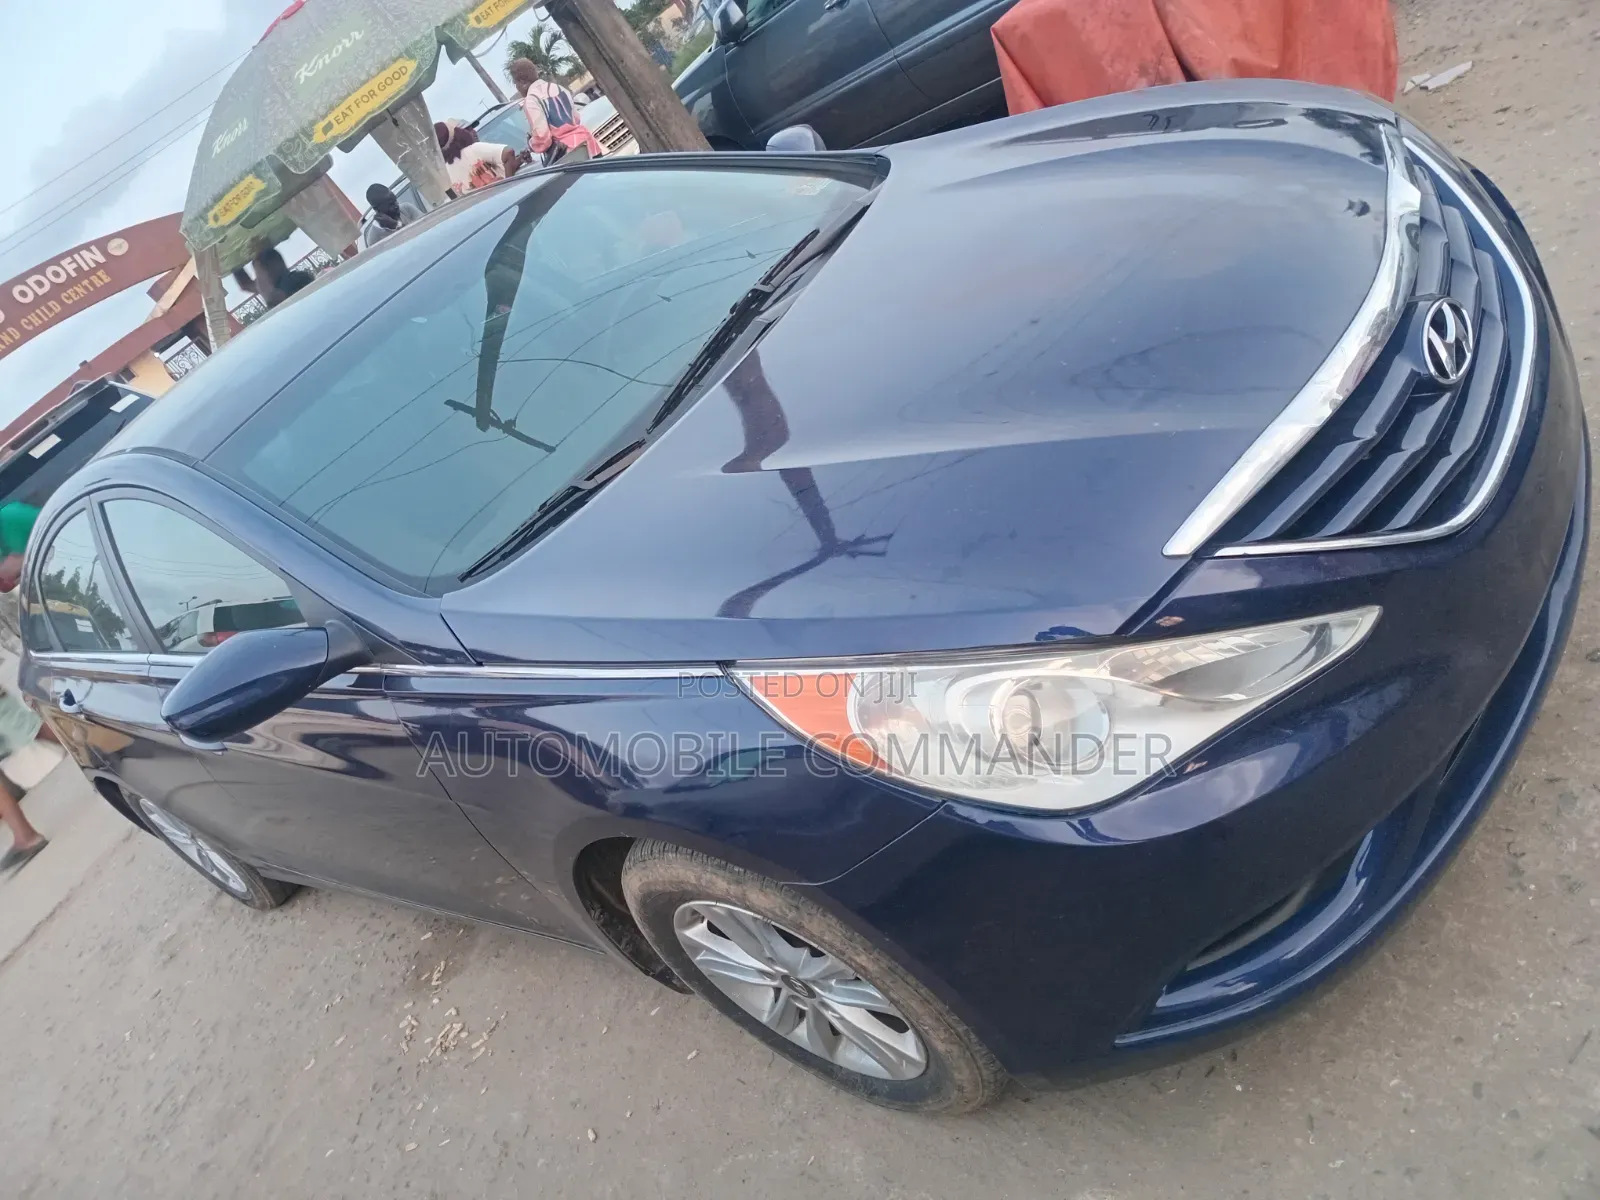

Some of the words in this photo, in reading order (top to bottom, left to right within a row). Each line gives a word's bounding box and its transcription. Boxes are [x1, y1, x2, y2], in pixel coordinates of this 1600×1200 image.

[480, 4, 495, 20] EAT
[294, 30, 364, 84] Knorr
[333, 105, 355, 125] EAT
[353, 89, 378, 108] FOR
[377, 65, 408, 92] GOOD
[12, 245, 107, 304] ODOFIN
[20, 300, 61, 330] CHILD
[61, 269, 112, 304] CENTRE
